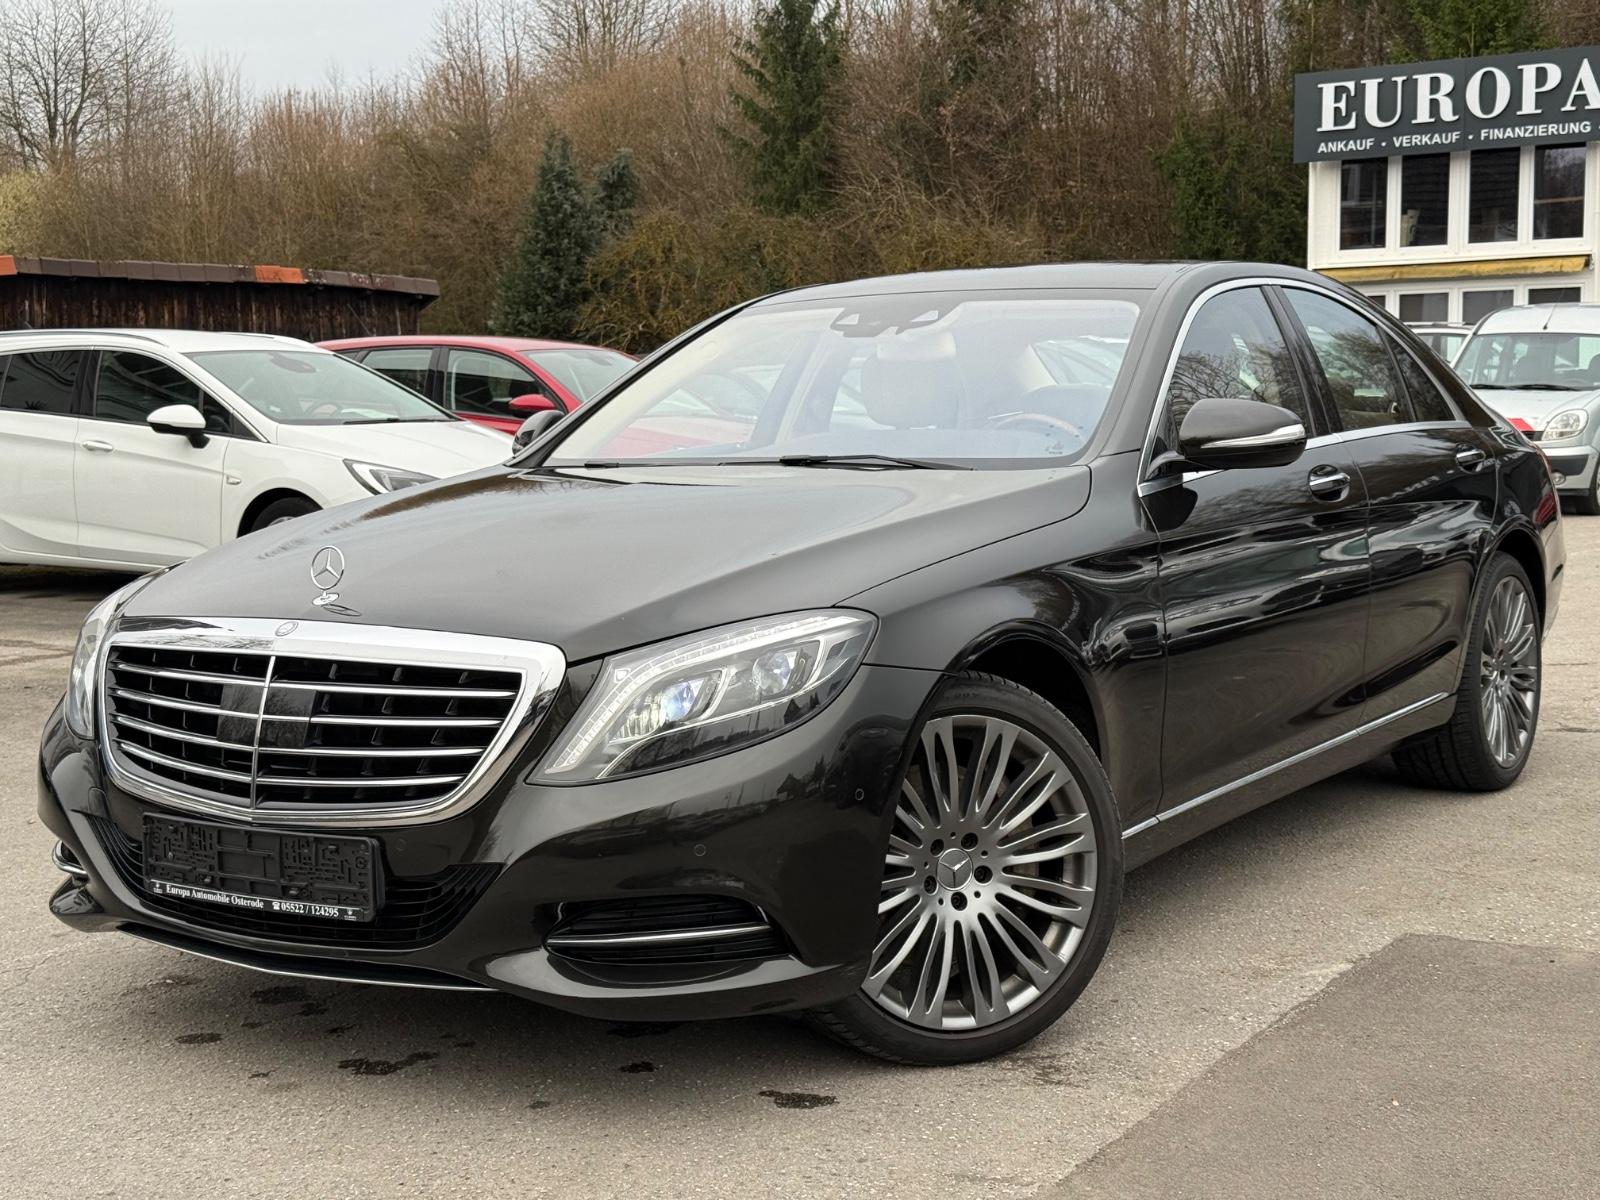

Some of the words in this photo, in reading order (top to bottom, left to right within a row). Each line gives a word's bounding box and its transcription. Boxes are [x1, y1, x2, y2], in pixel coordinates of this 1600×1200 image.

[1317, 58, 1600, 132] EUROPA
[1317, 138, 1375, 153] ANKAUF
[1393, 131, 1461, 148] VERKAUF
[1481, 121, 1592, 141] FINANZIERUNG
[166, 884, 190, 898] Europa
[191, 888, 229, 904] Automobile
[231, 894, 264, 909] Osterode
[281, 902, 304, 914] 05522
[311, 905, 339, 918] 124295
